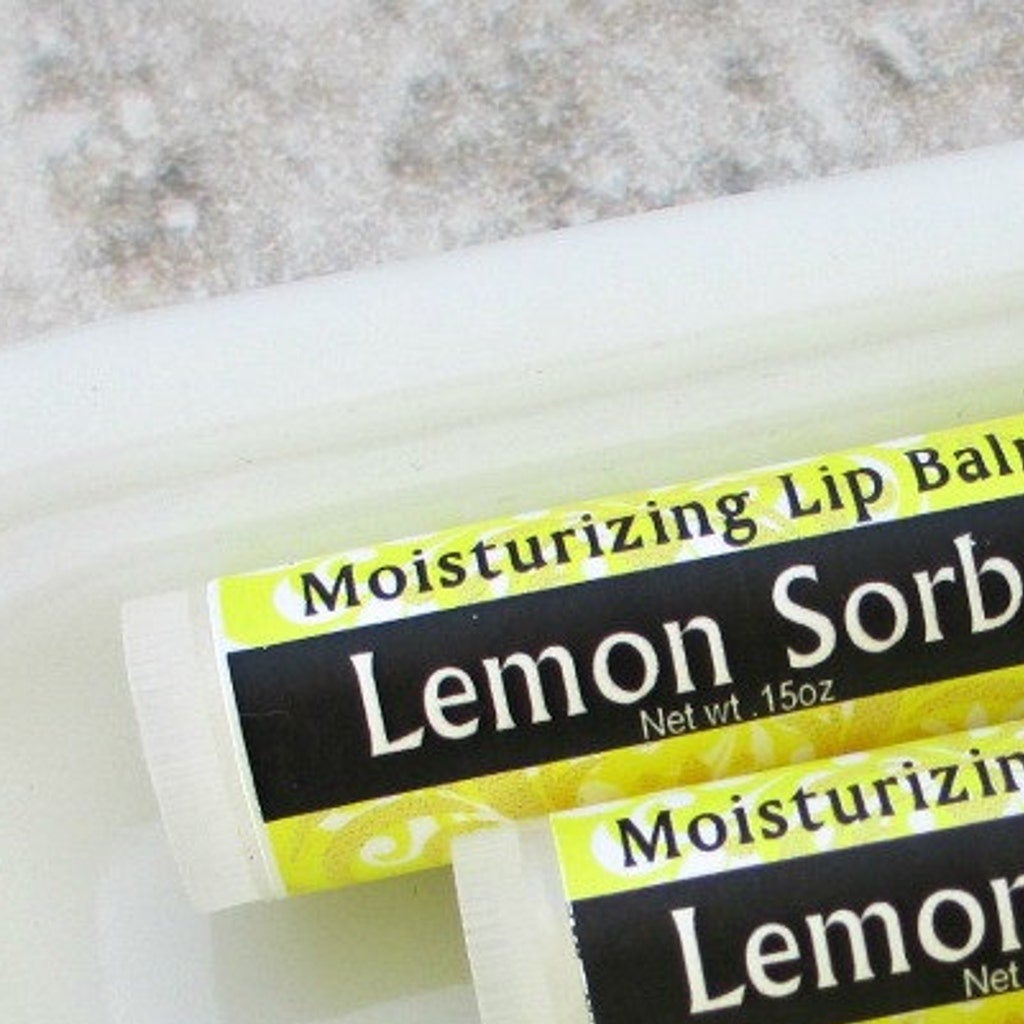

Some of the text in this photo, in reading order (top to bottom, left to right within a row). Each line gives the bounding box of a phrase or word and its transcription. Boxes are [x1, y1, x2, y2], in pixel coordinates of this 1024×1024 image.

[302, 489, 757, 616] Moisturizing
[780, 464, 885, 524] Lip
[350, 615, 732, 757] Lemon
[640, 677, 836, 741] Net wt .15oz
[963, 965, 1020, 998] Net
